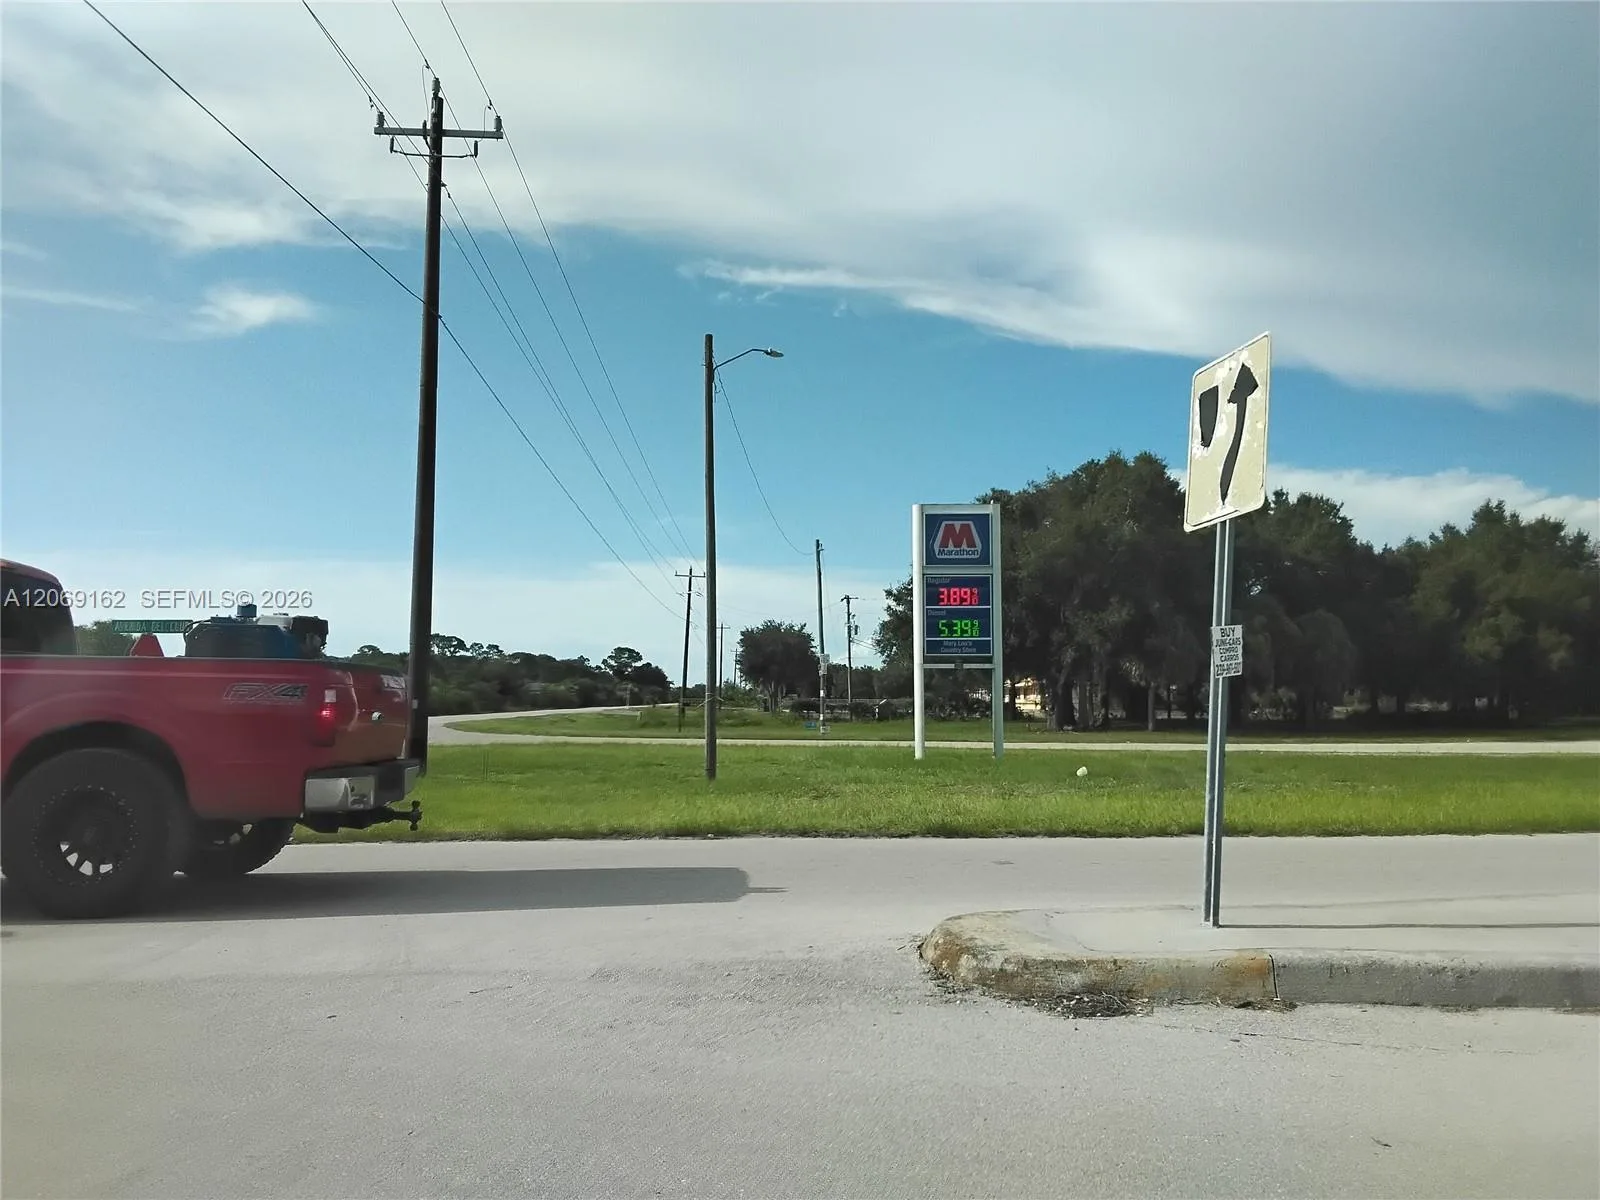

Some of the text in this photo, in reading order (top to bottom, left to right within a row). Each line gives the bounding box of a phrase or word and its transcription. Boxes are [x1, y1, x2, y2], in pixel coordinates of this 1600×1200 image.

[938, 523, 977, 549] M
[937, 548, 979, 556] Marathon
[927, 577, 951, 585] Regular
[938, 587, 971, 606] 3.89
[938, 619, 971, 637] 5.39
[1220, 627, 1236, 638] BUY
[1220, 654, 1240, 662] CARROS
[223, 683, 309, 701] FX4
